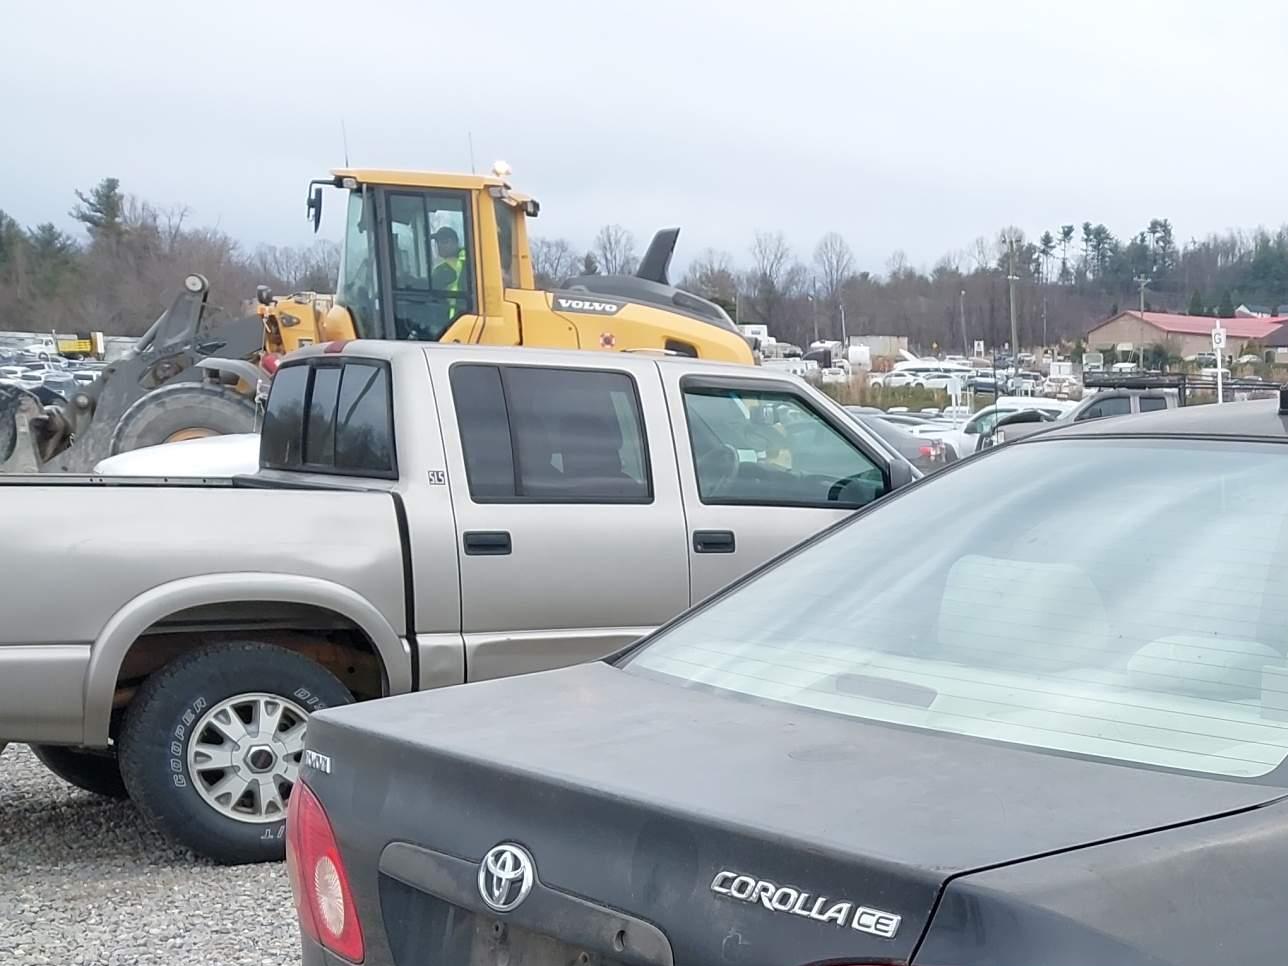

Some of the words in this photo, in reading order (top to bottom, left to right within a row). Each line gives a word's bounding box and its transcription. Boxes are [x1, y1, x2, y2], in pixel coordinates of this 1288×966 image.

[557, 298, 618, 312] VOLVO
[170, 696, 207, 787] COOPER
[710, 871, 852, 927] COROLLA
[855, 908, 897, 936] CE
